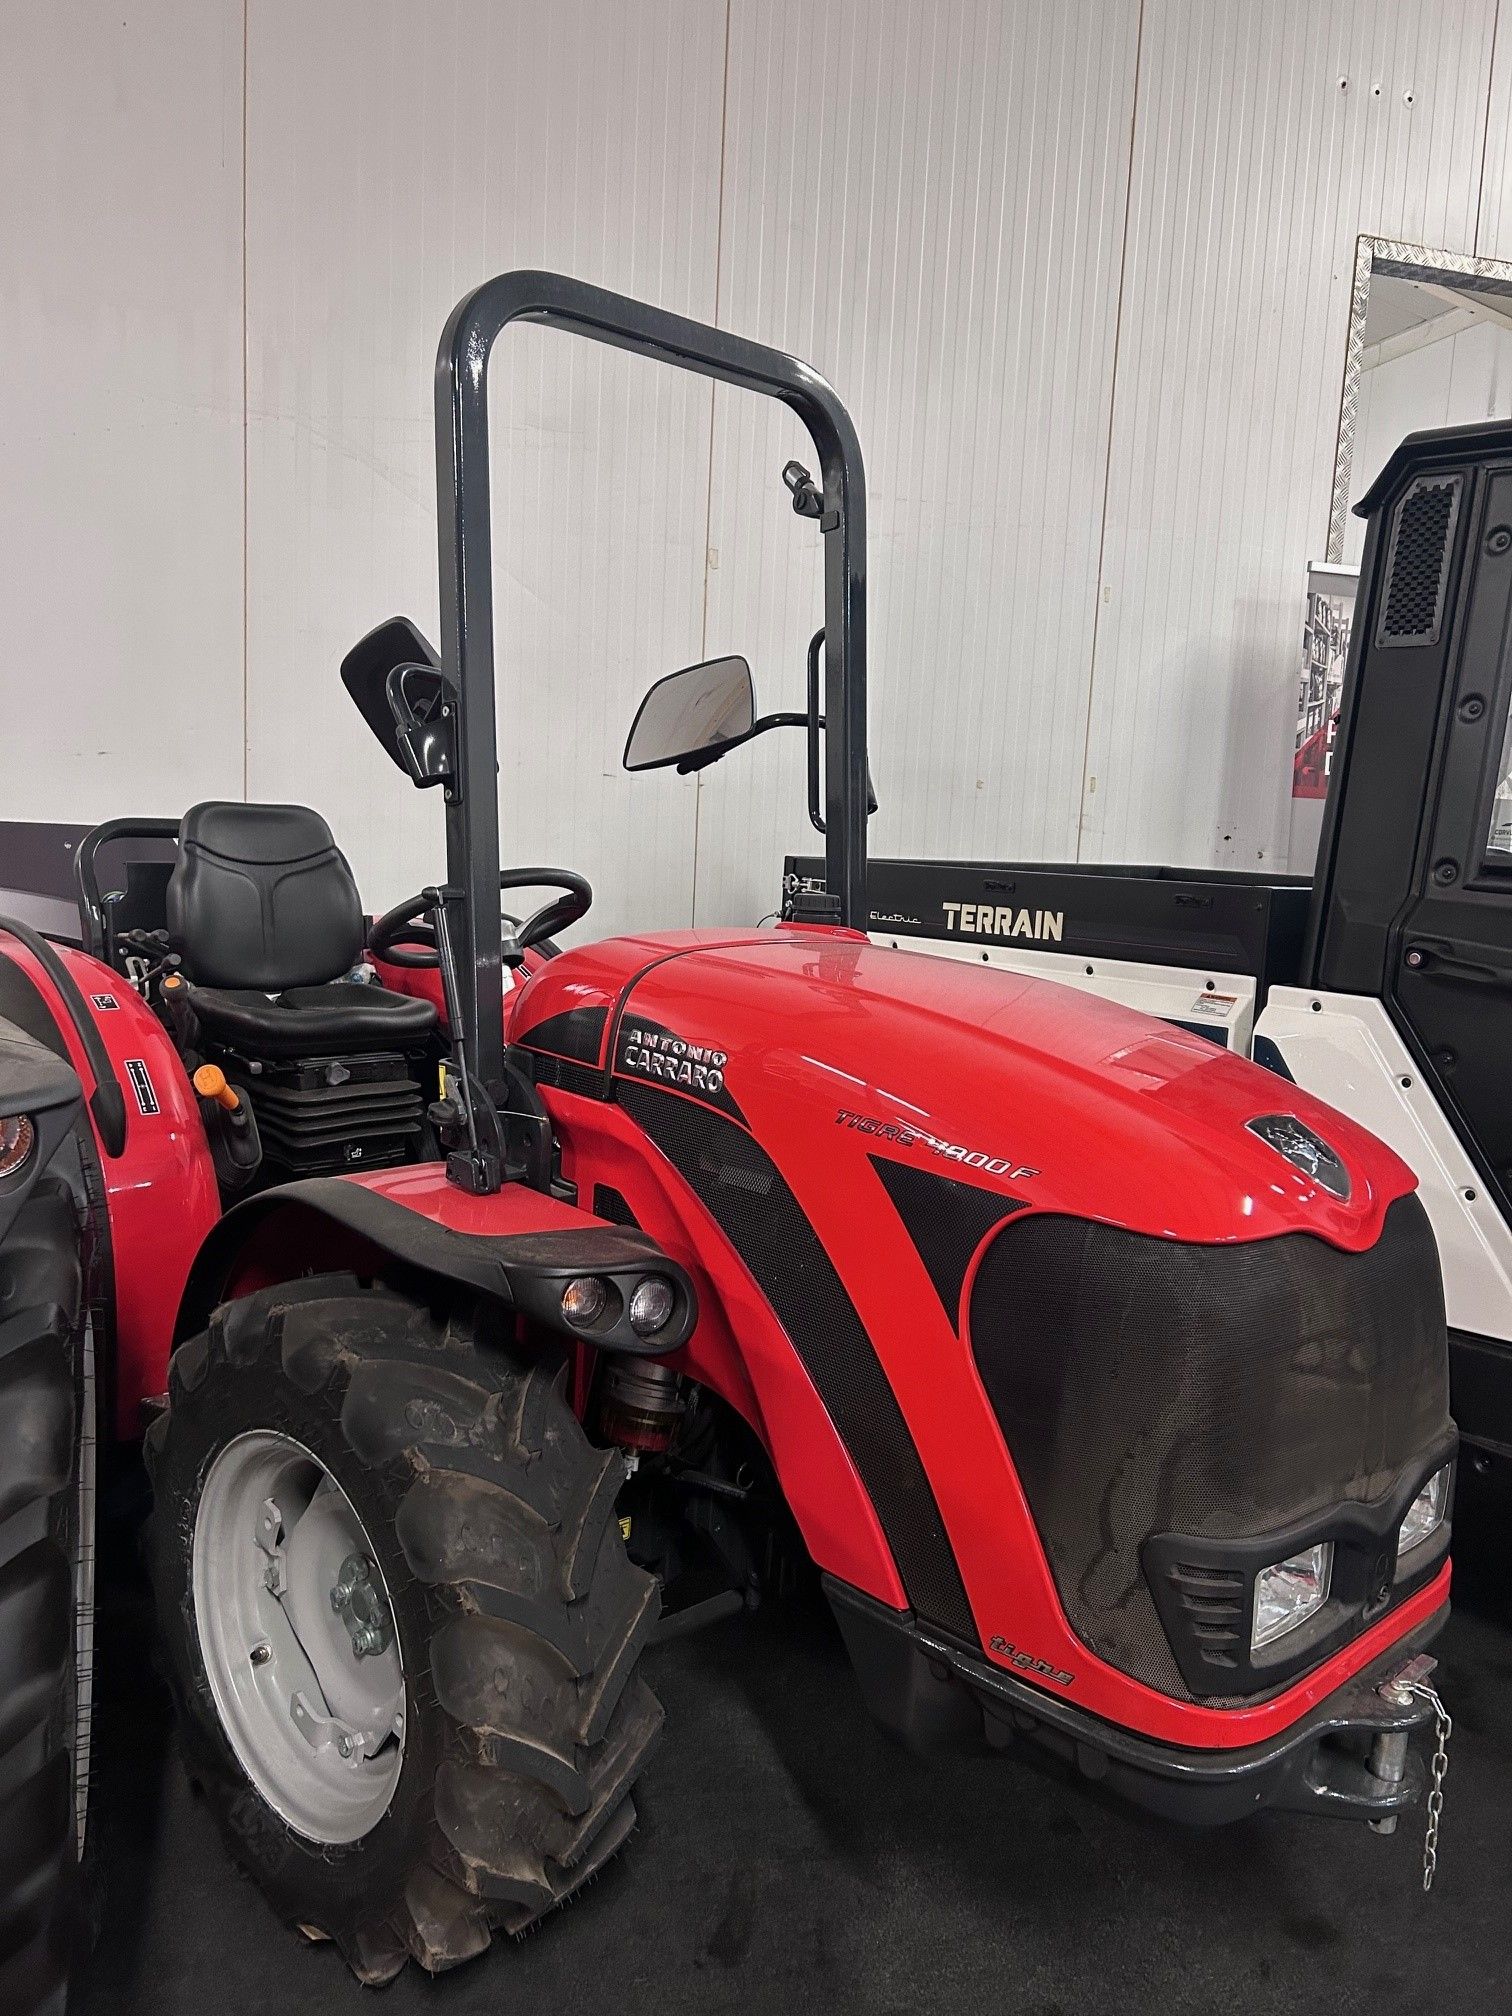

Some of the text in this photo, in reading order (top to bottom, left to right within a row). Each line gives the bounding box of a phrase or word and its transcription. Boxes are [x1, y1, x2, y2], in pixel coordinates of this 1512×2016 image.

[870, 910, 922, 924] Electric
[942, 902, 1064, 942] TERRAIN
[624, 1045, 724, 1093] CARRARO
[629, 1028, 728, 1066] ANTONIO
[834, 1109, 916, 1148] TIGRE
[1008, 1164, 1043, 1180] F
[989, 1635, 1076, 1687] tigre
